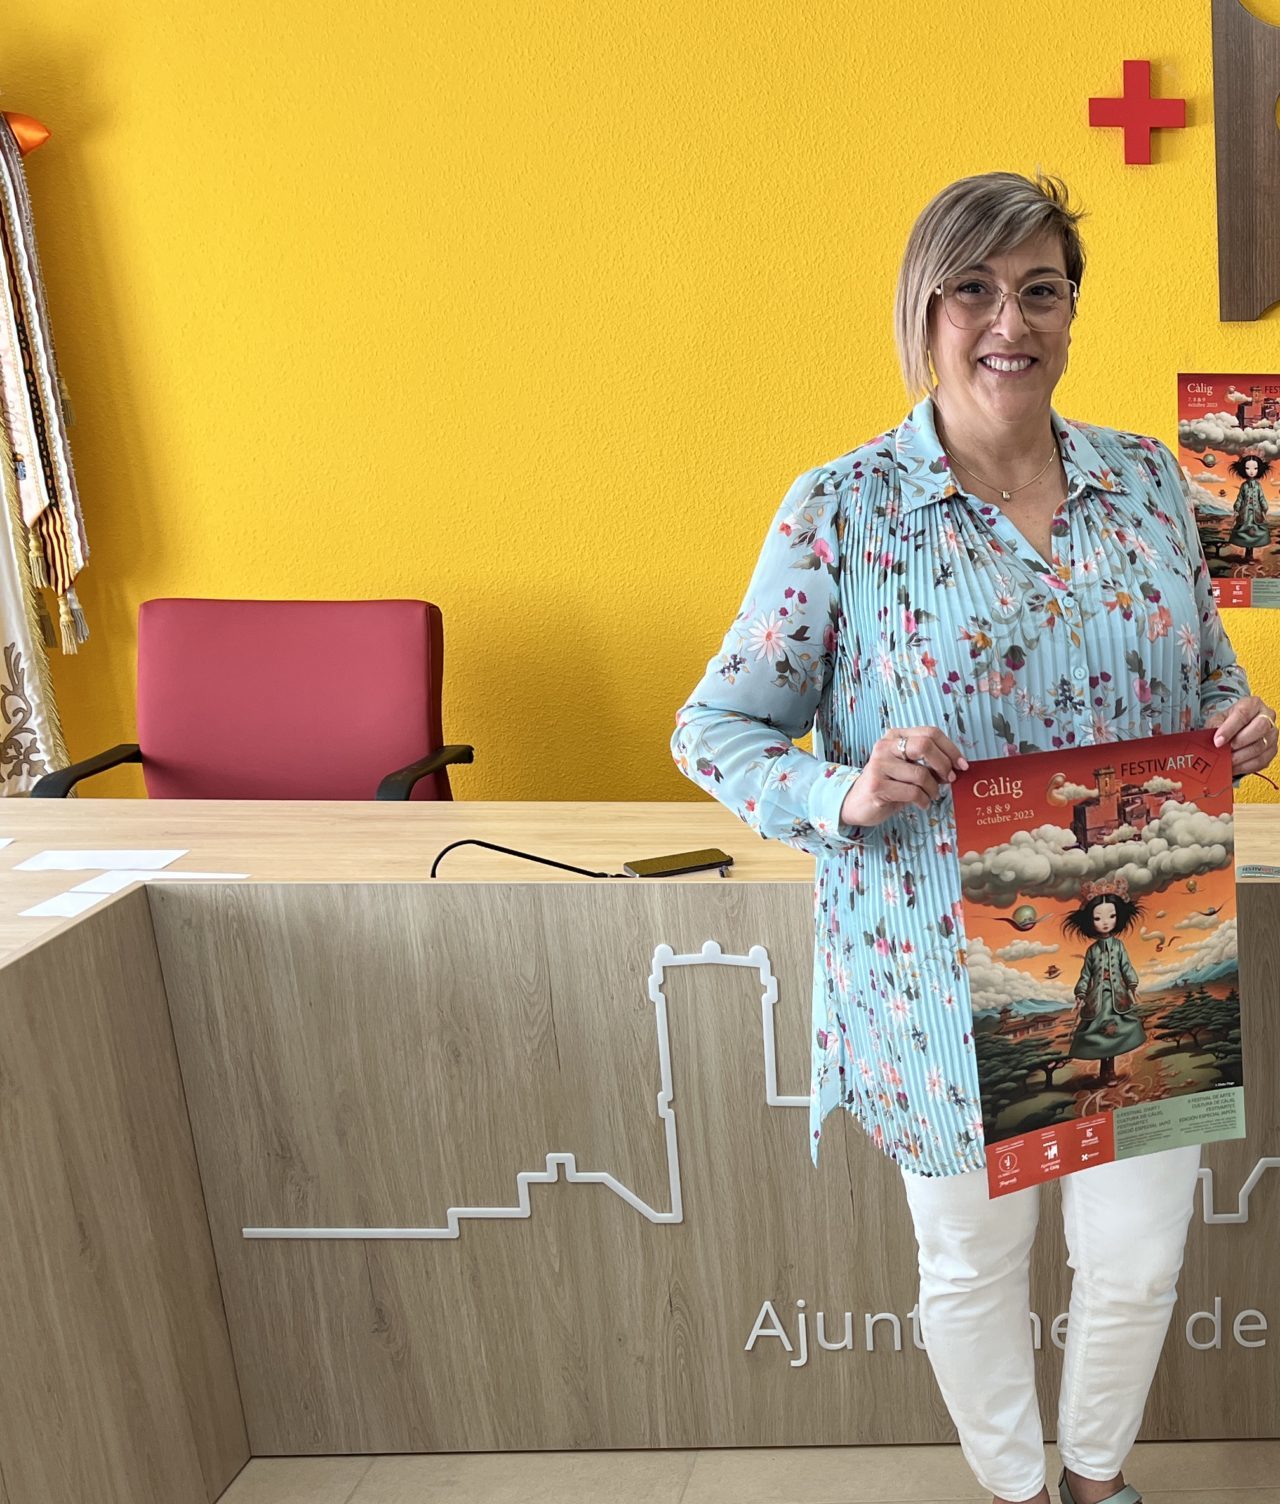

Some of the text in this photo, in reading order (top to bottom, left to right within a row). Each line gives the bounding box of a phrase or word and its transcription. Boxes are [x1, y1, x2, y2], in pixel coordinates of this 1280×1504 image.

[1187, 382, 1214, 396] Càlig
[973, 776, 1023, 799] Càlig
[986, 805, 993, 814] 8
[994, 804, 1003, 813] &
[1004, 803, 1011, 812] 9
[976, 809, 1035, 826] octubre 2023
[1185, 1296, 1268, 1350] de
